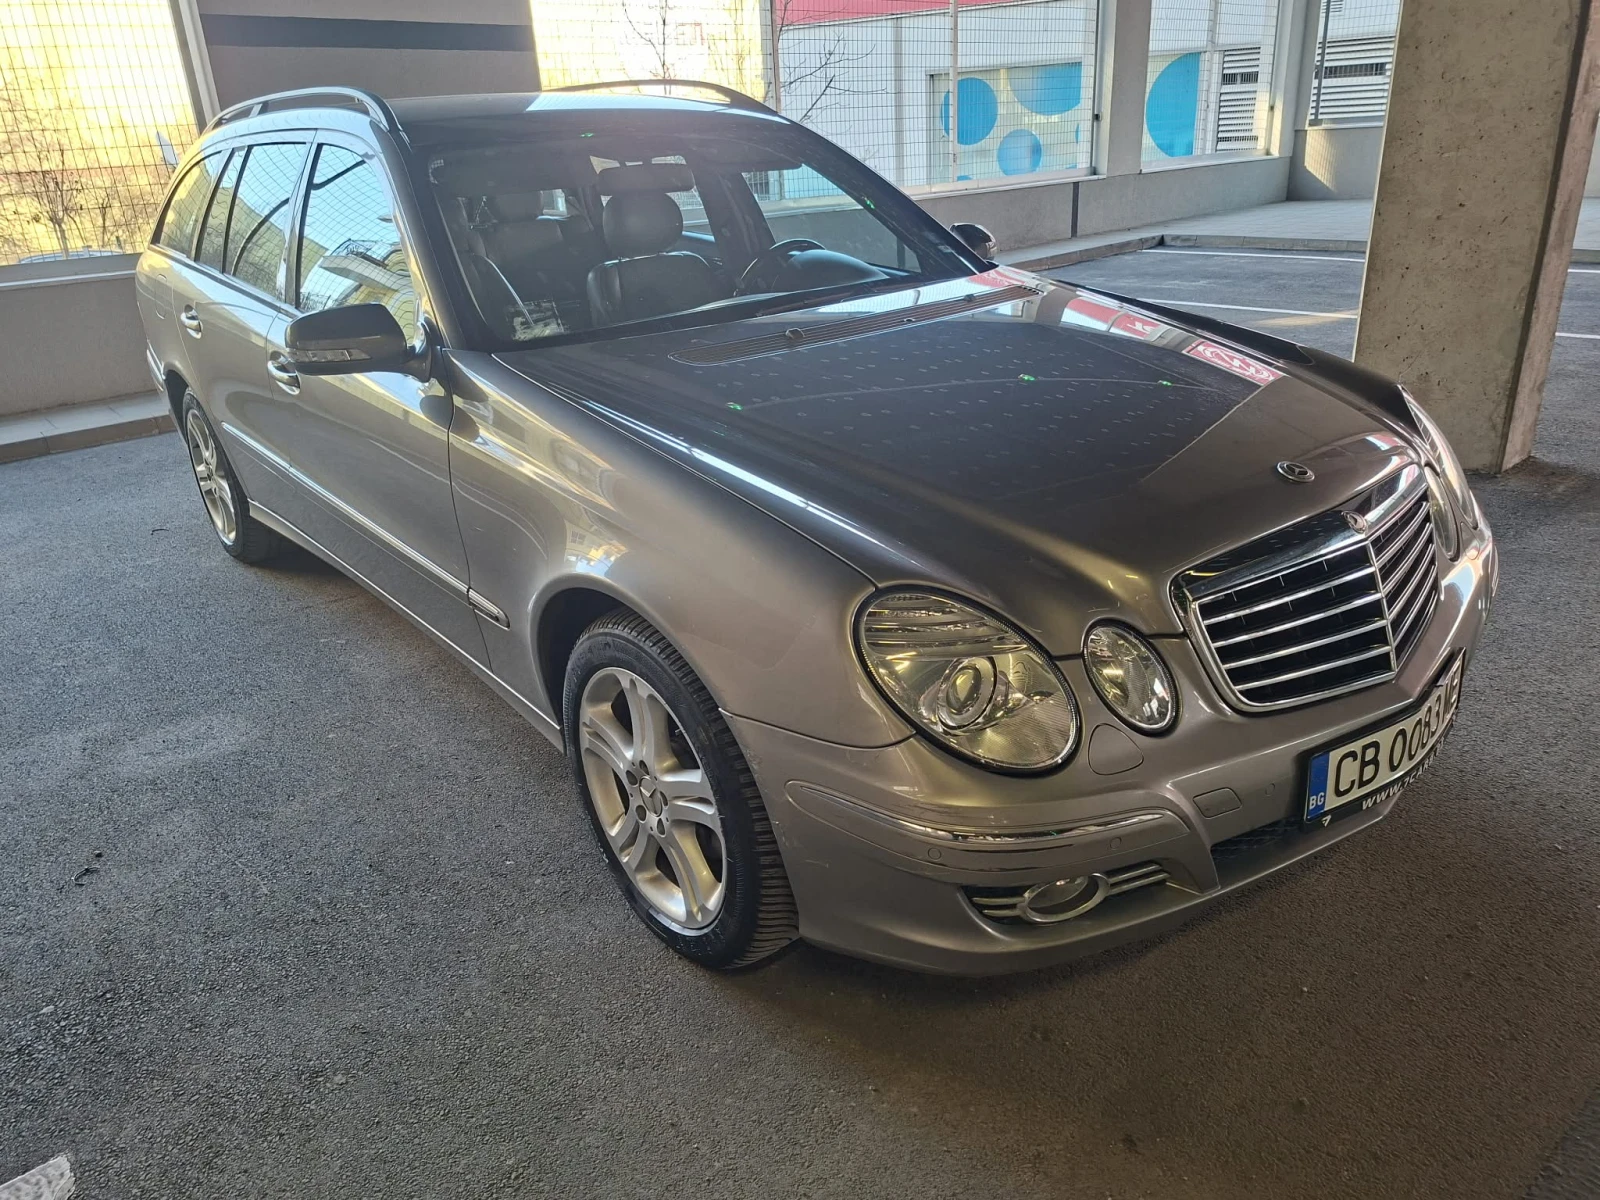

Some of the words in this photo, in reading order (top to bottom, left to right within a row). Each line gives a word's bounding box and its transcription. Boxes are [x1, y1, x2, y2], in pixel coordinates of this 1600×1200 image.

[1334, 741, 1380, 797] CB
[1389, 695, 1441, 772] 0083
[1309, 792, 1325, 810] BG
